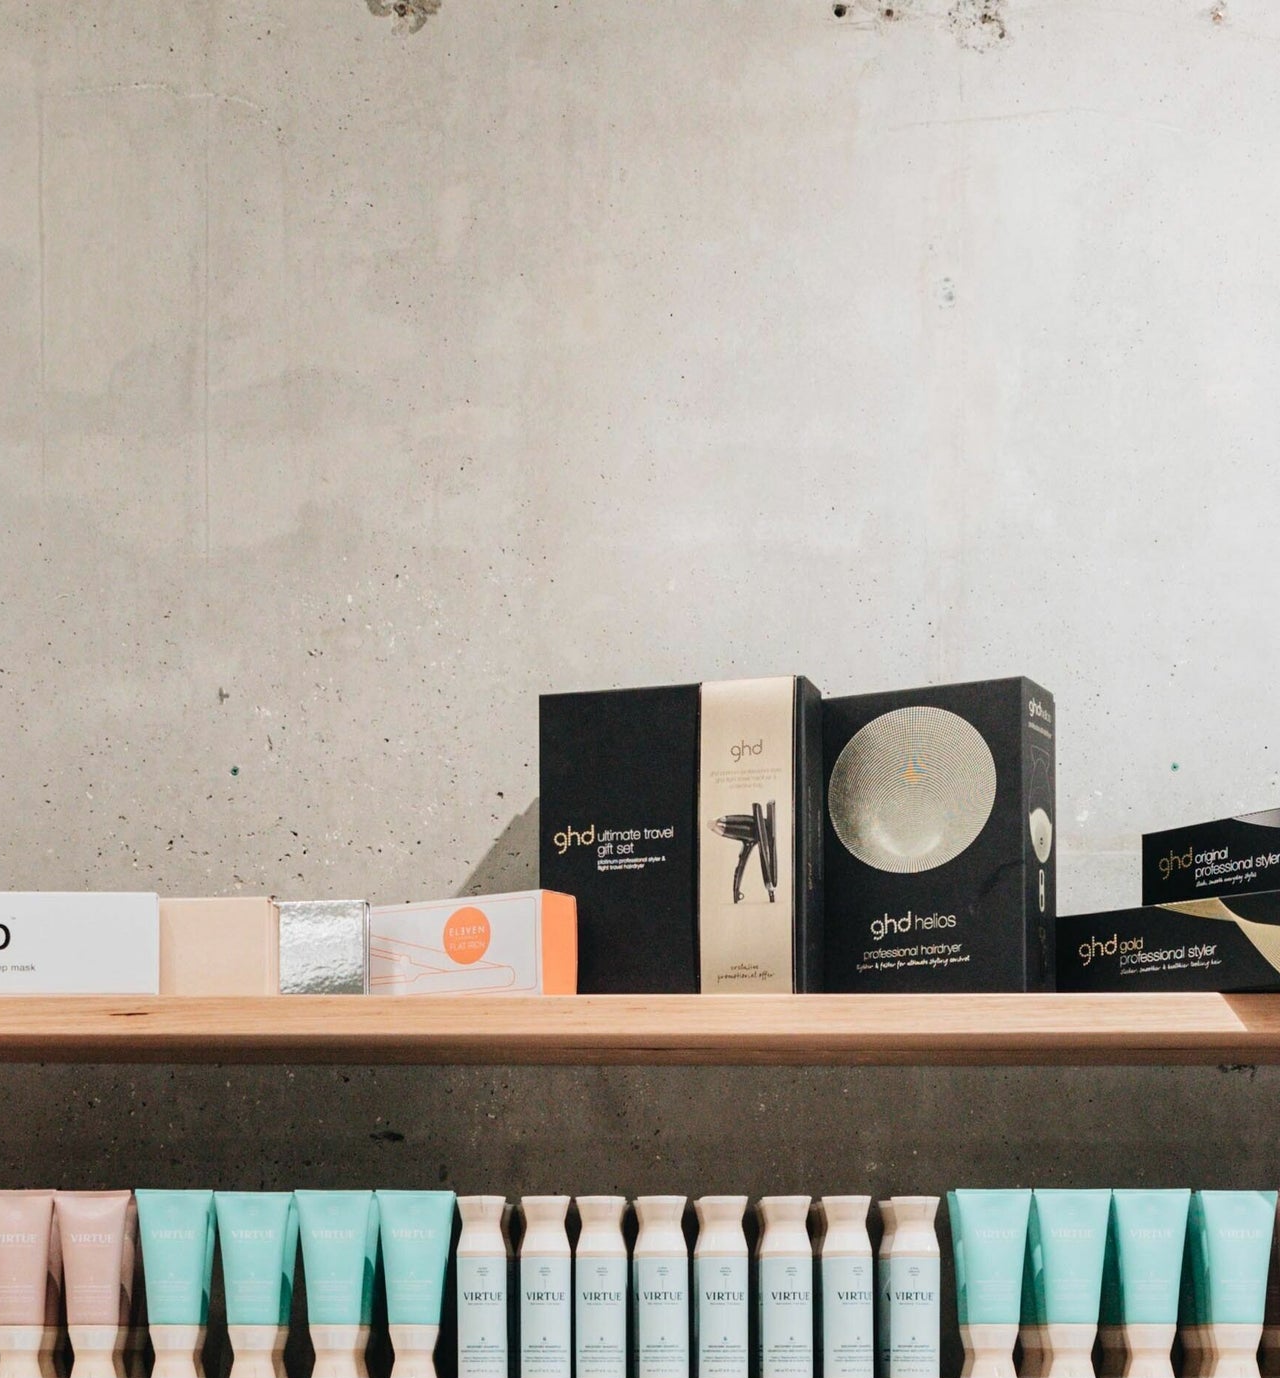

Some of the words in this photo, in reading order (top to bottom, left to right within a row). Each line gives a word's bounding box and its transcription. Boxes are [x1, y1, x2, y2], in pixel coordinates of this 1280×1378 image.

[730, 738, 763, 763] ghd
[553, 824, 595, 854] ghd
[597, 830, 640, 842] ultimate
[644, 826, 674, 840] travel
[597, 842, 614, 858] gift
[616, 842, 634, 854] set
[1158, 846, 1193, 880] ghd
[1195, 846, 1228, 865] original
[1195, 856, 1254, 880] professional
[870, 910, 912, 940] ghd
[915, 912, 957, 930] helios
[863, 946, 918, 960] professional
[920, 943, 963, 956] hairdryer
[1078, 933, 1118, 966] ghd
[1120, 937, 1144, 954] gold
[1120, 946, 1185, 966] professional
[1188, 944, 1217, 960] styler
[10, 963, 36, 972] mask
[70, 1234, 114, 1243] VIRTUE
[464, 1292, 504, 1300] VIRTUE
[526, 1292, 566, 1300] VIRTUE
[582, 1292, 622, 1300] VIRTUE
[644, 1292, 683, 1300] VIRTUE
[706, 1292, 745, 1300] VIRTUE
[771, 1292, 810, 1300] VIRTUE
[896, 1292, 934, 1300] VIRTUE
